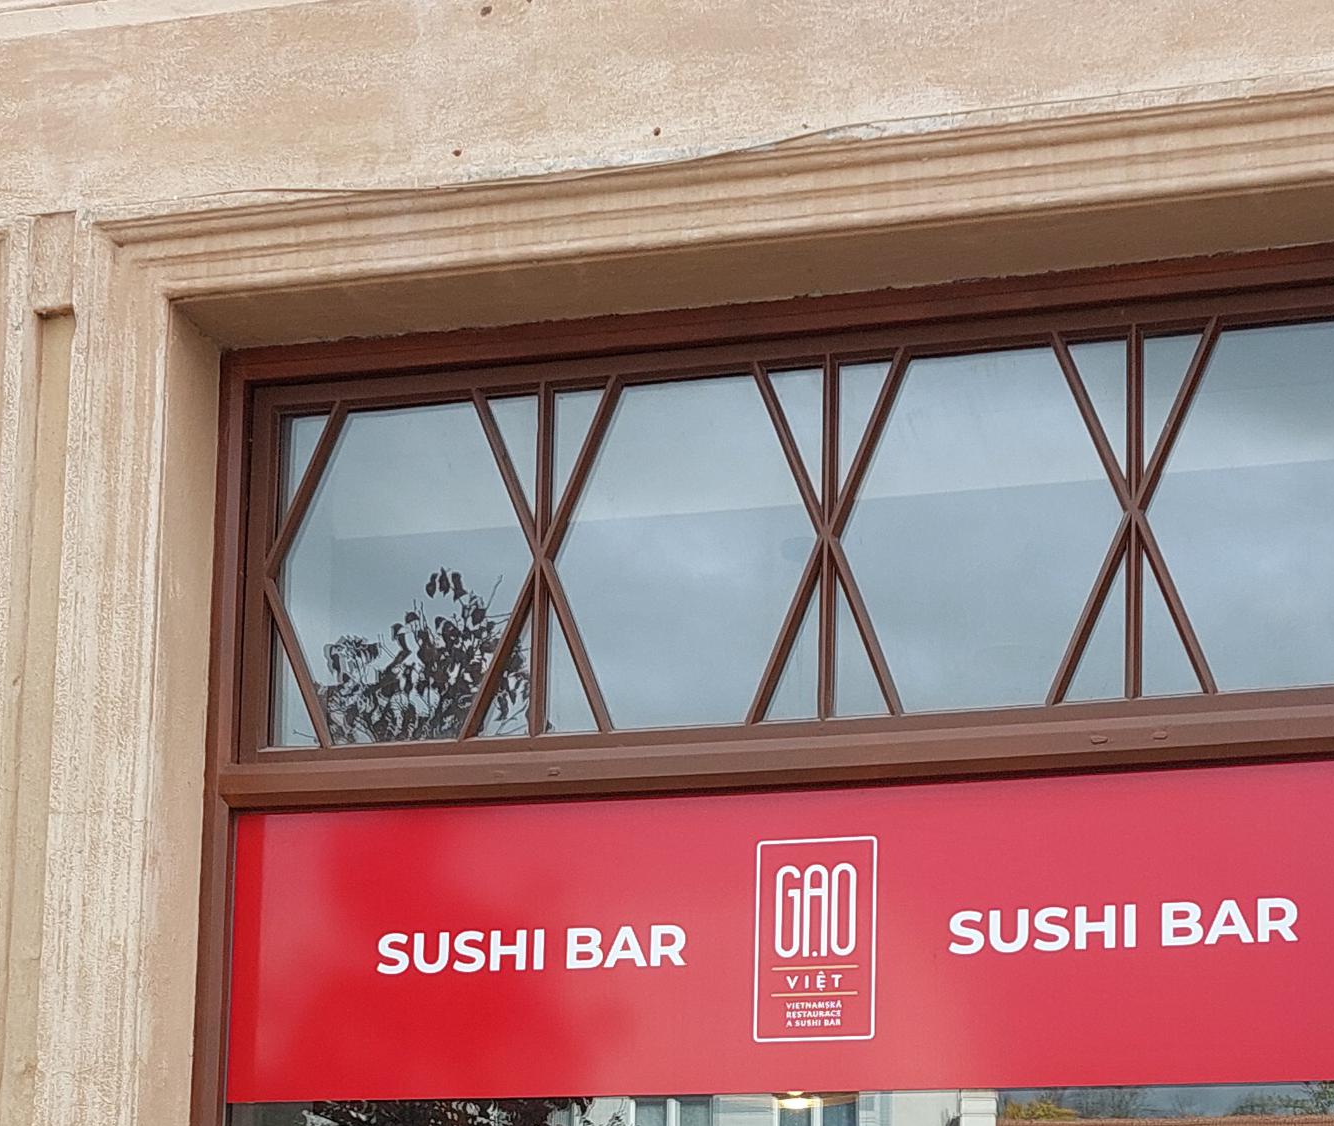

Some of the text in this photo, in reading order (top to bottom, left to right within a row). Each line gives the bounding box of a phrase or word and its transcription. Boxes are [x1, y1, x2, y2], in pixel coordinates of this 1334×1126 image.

[948, 897, 1298, 955] SUSHI BAR
[377, 924, 686, 975] SUSHI BAR
[785, 970, 843, 992] VIỆT
[786, 1000, 842, 1010] VIETNAMSKÁ
[787, 1010, 842, 1019] RESTAURACE
[795, 1019, 821, 1028] SUSHI
[824, 1018, 842, 1027] BAR
